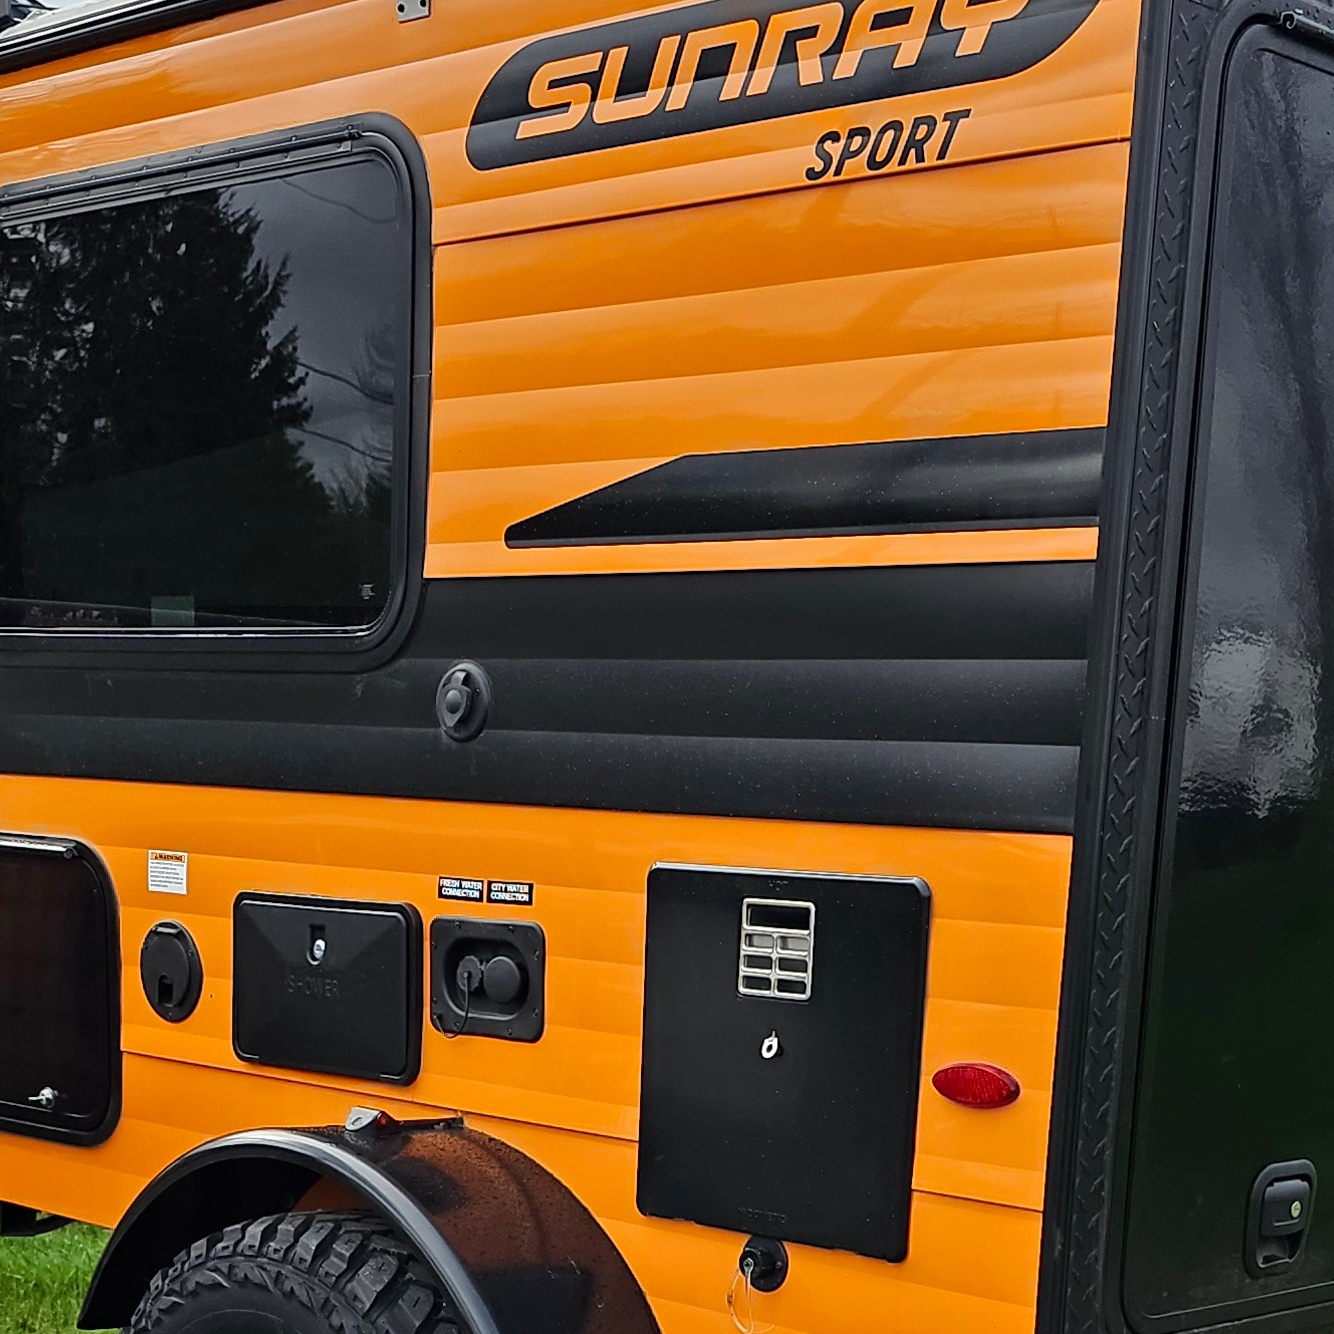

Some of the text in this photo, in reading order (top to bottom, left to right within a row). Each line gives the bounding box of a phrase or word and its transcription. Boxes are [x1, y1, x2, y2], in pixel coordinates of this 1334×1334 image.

[515, 0, 1027, 139] SUNRAY
[804, 107, 973, 182] SPORT
[461, 880, 483, 890] WATER
[491, 883, 529, 893] CITY WATER
[442, 887, 479, 898] CONNECTION
[490, 891, 529, 901] CONNECTION
[287, 975, 340, 998] SHOWER
